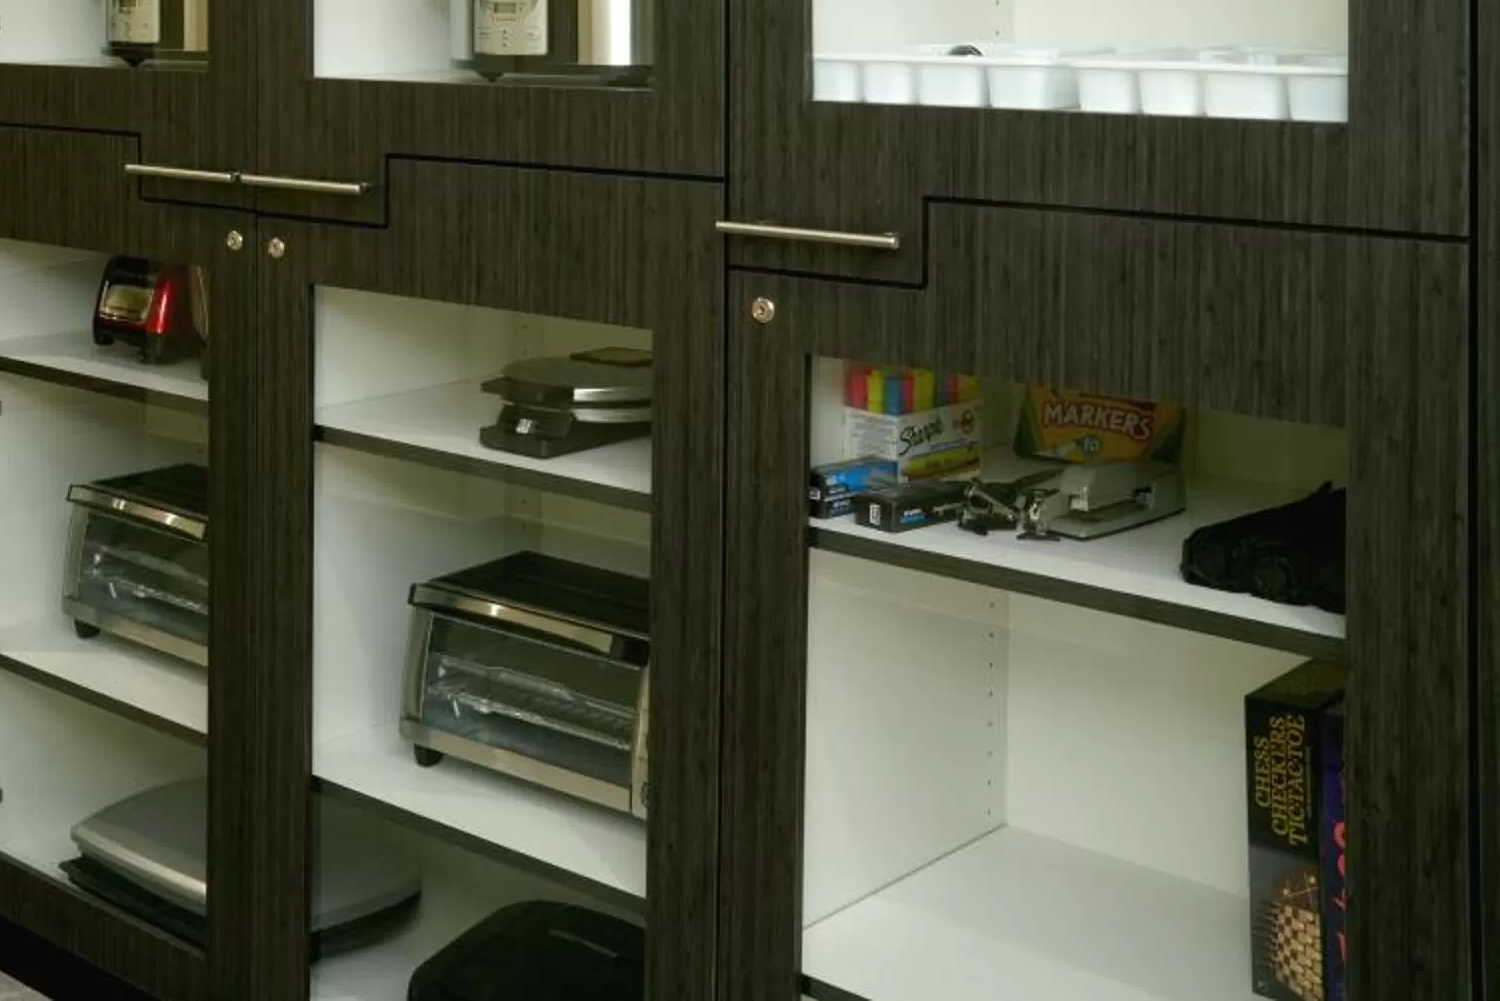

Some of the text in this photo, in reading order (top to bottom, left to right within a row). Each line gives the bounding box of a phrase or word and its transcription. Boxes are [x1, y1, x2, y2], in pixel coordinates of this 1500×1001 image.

[1043, 401, 1152, 441] MARKERS
[1254, 735, 1271, 807] CHESS
[1270, 715, 1288, 836] CHECKERS
